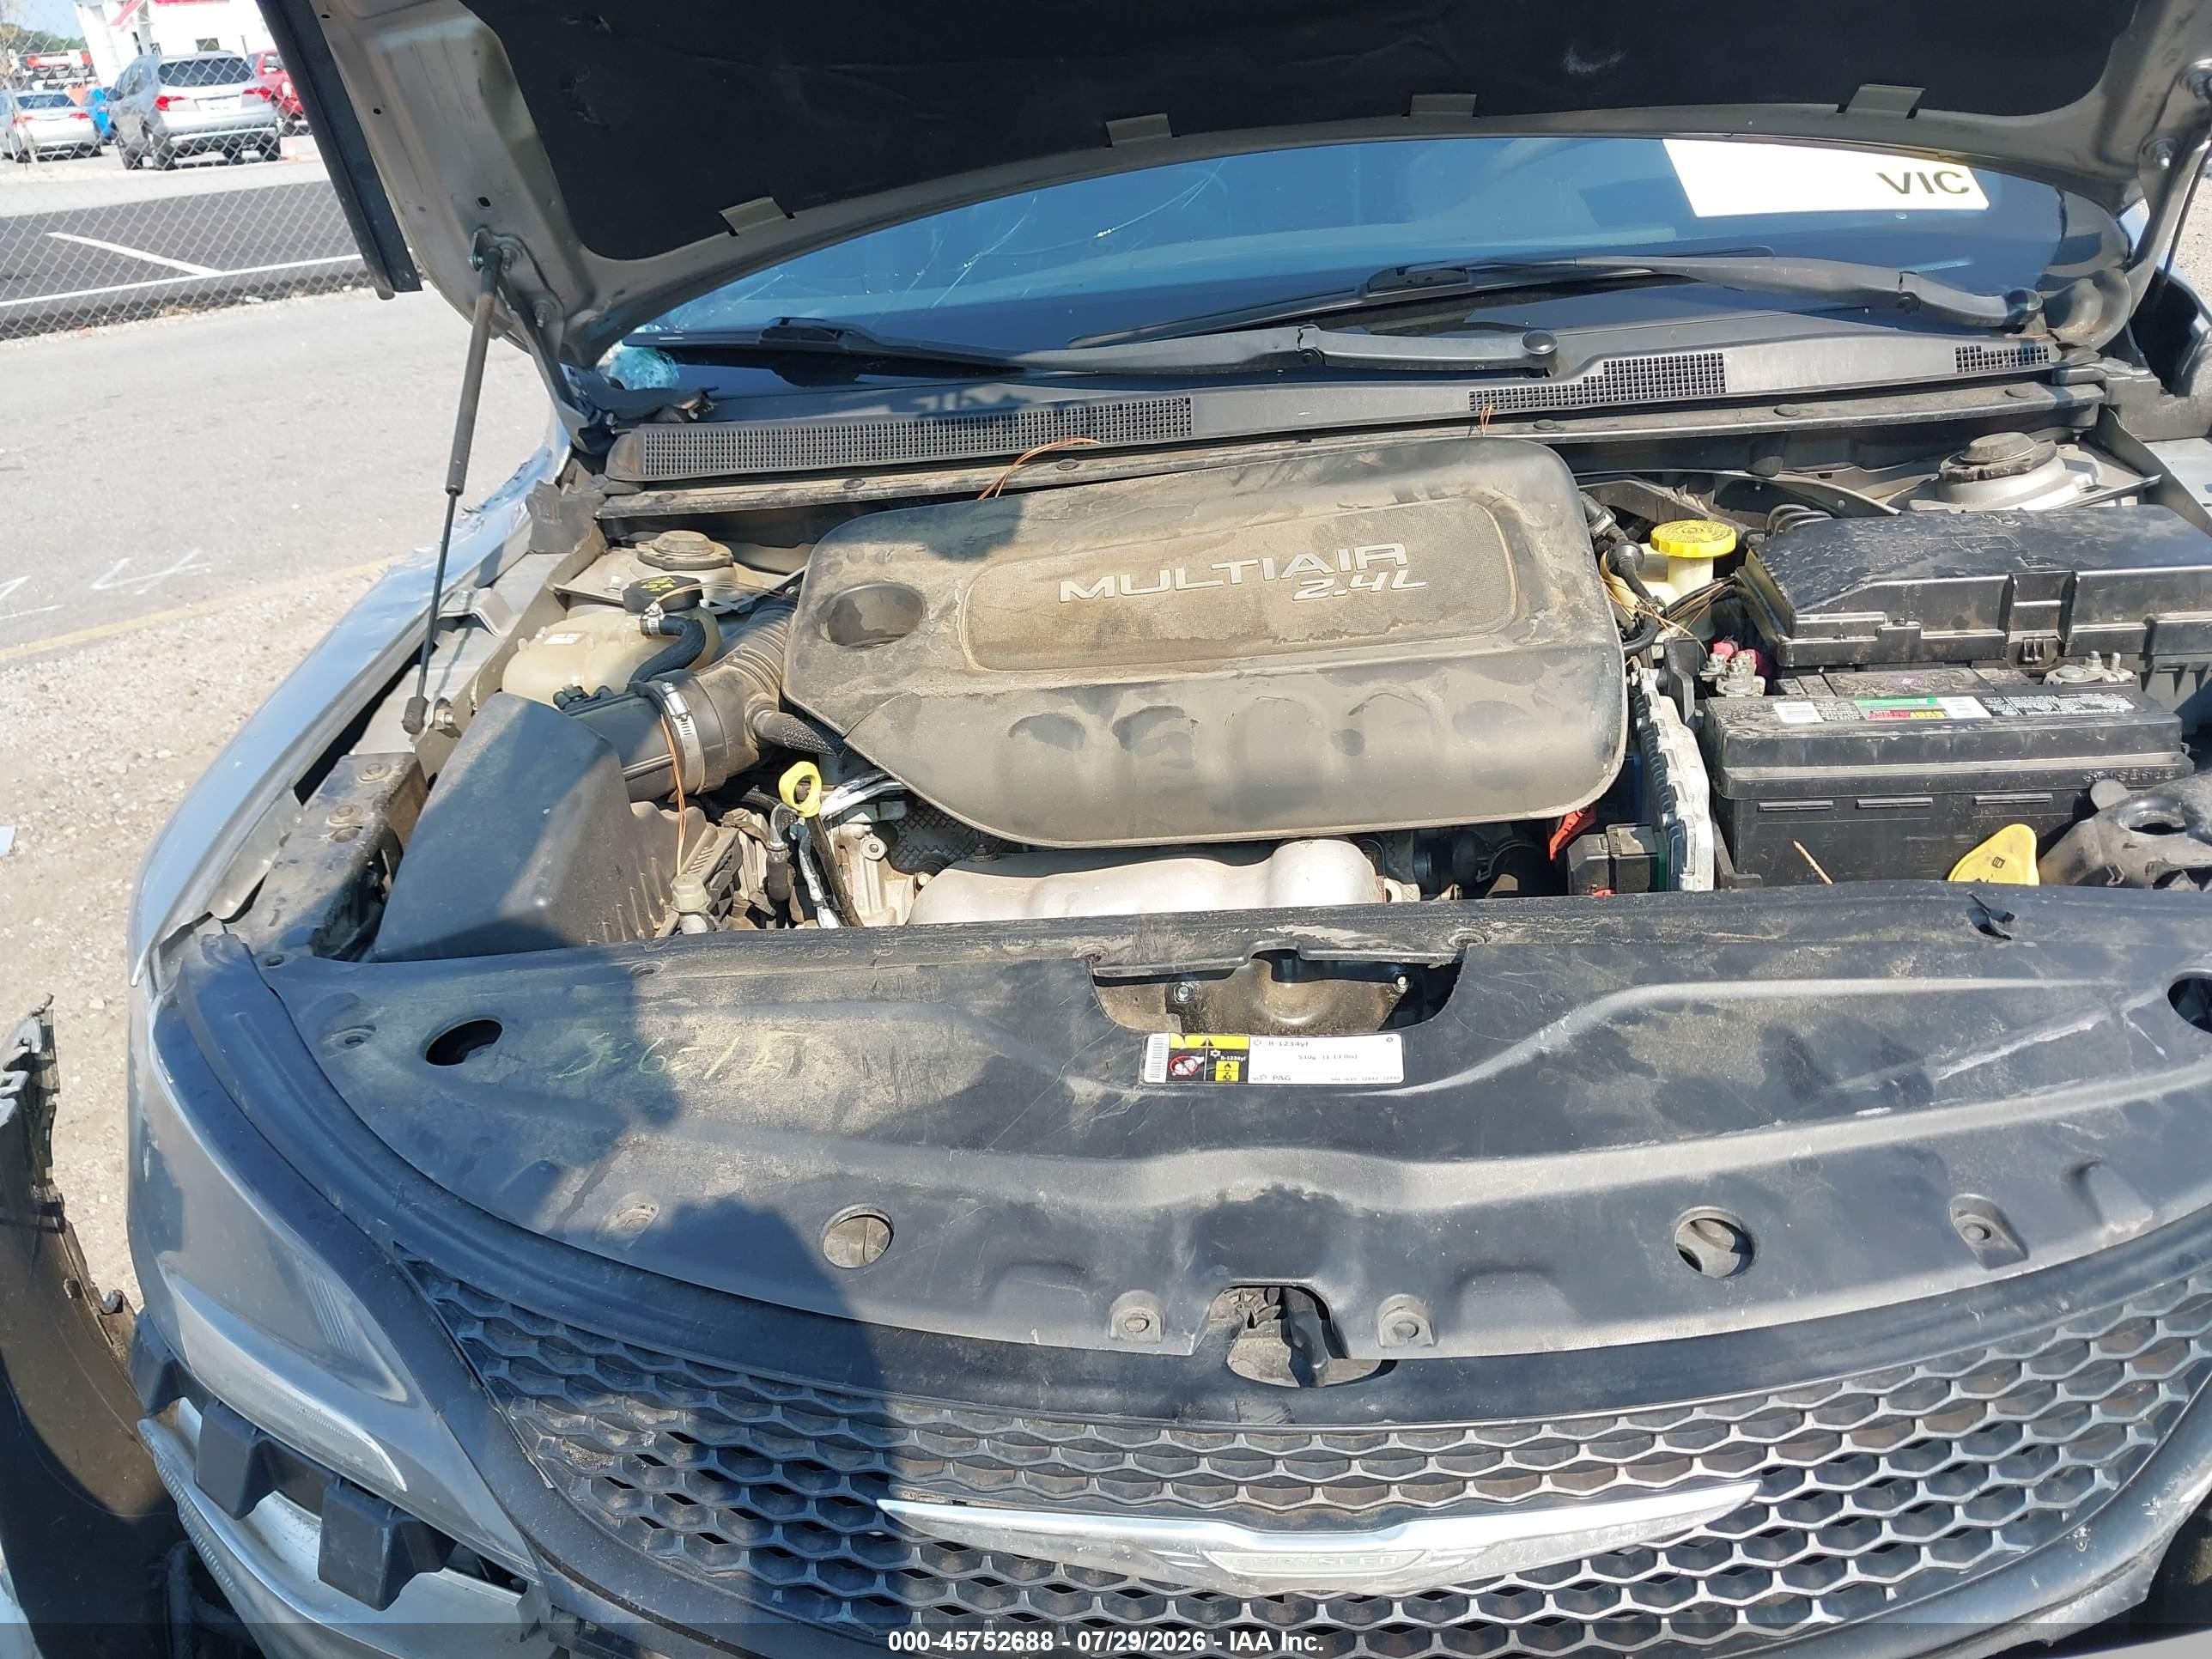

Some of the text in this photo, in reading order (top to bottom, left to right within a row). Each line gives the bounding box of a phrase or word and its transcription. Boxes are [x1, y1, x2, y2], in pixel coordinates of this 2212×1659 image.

[1875, 170, 1970, 194] VIC
[1059, 543, 1408, 603] MULTIAIR
[1291, 569, 1427, 601] 2.4L
[1232, 1554, 1399, 1568] CHRYSLER
